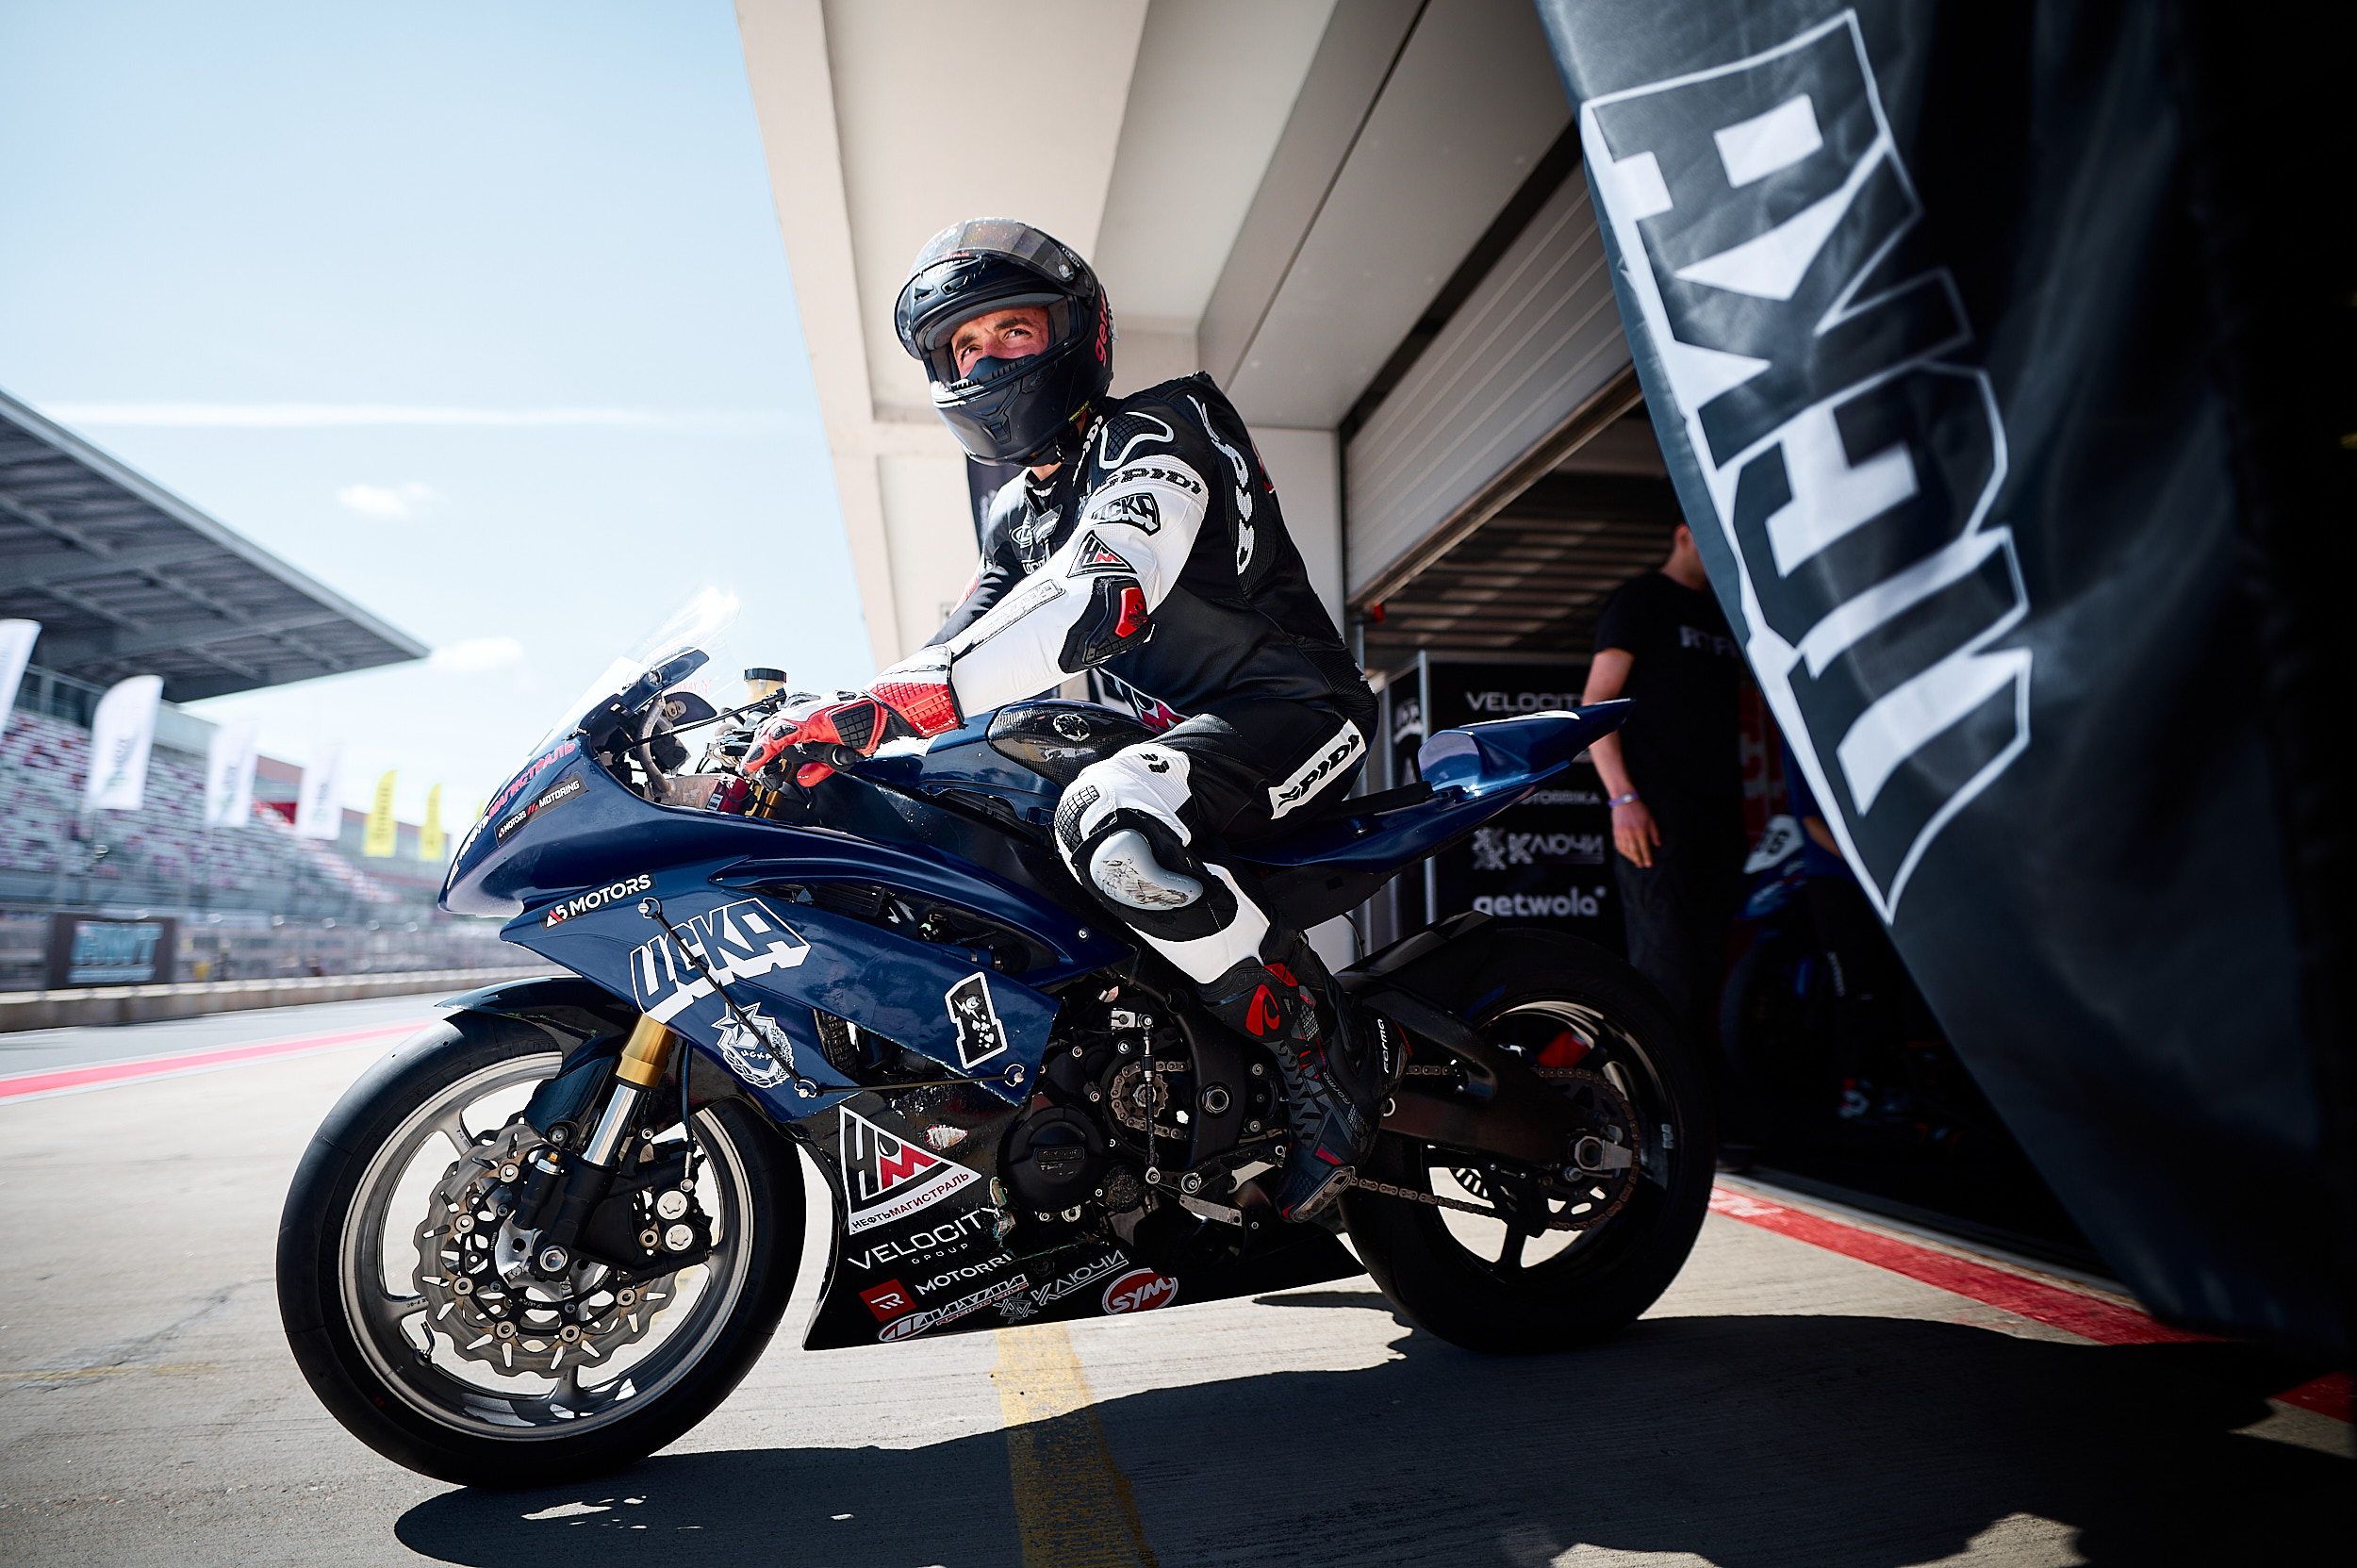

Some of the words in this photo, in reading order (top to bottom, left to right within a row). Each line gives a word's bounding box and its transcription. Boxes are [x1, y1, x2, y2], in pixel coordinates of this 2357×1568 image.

[538, 780, 581, 808] MOTORING
[1518, 788, 1601, 805] OTORRIKA
[569, 873, 651, 916] MOTORS
[851, 1173, 970, 1230] НЕФТЬМАГИСТРАЛЬ
[1030, 1249, 1129, 1307] КЛЮЧИ
[1112, 1277, 1176, 1315] SYM
